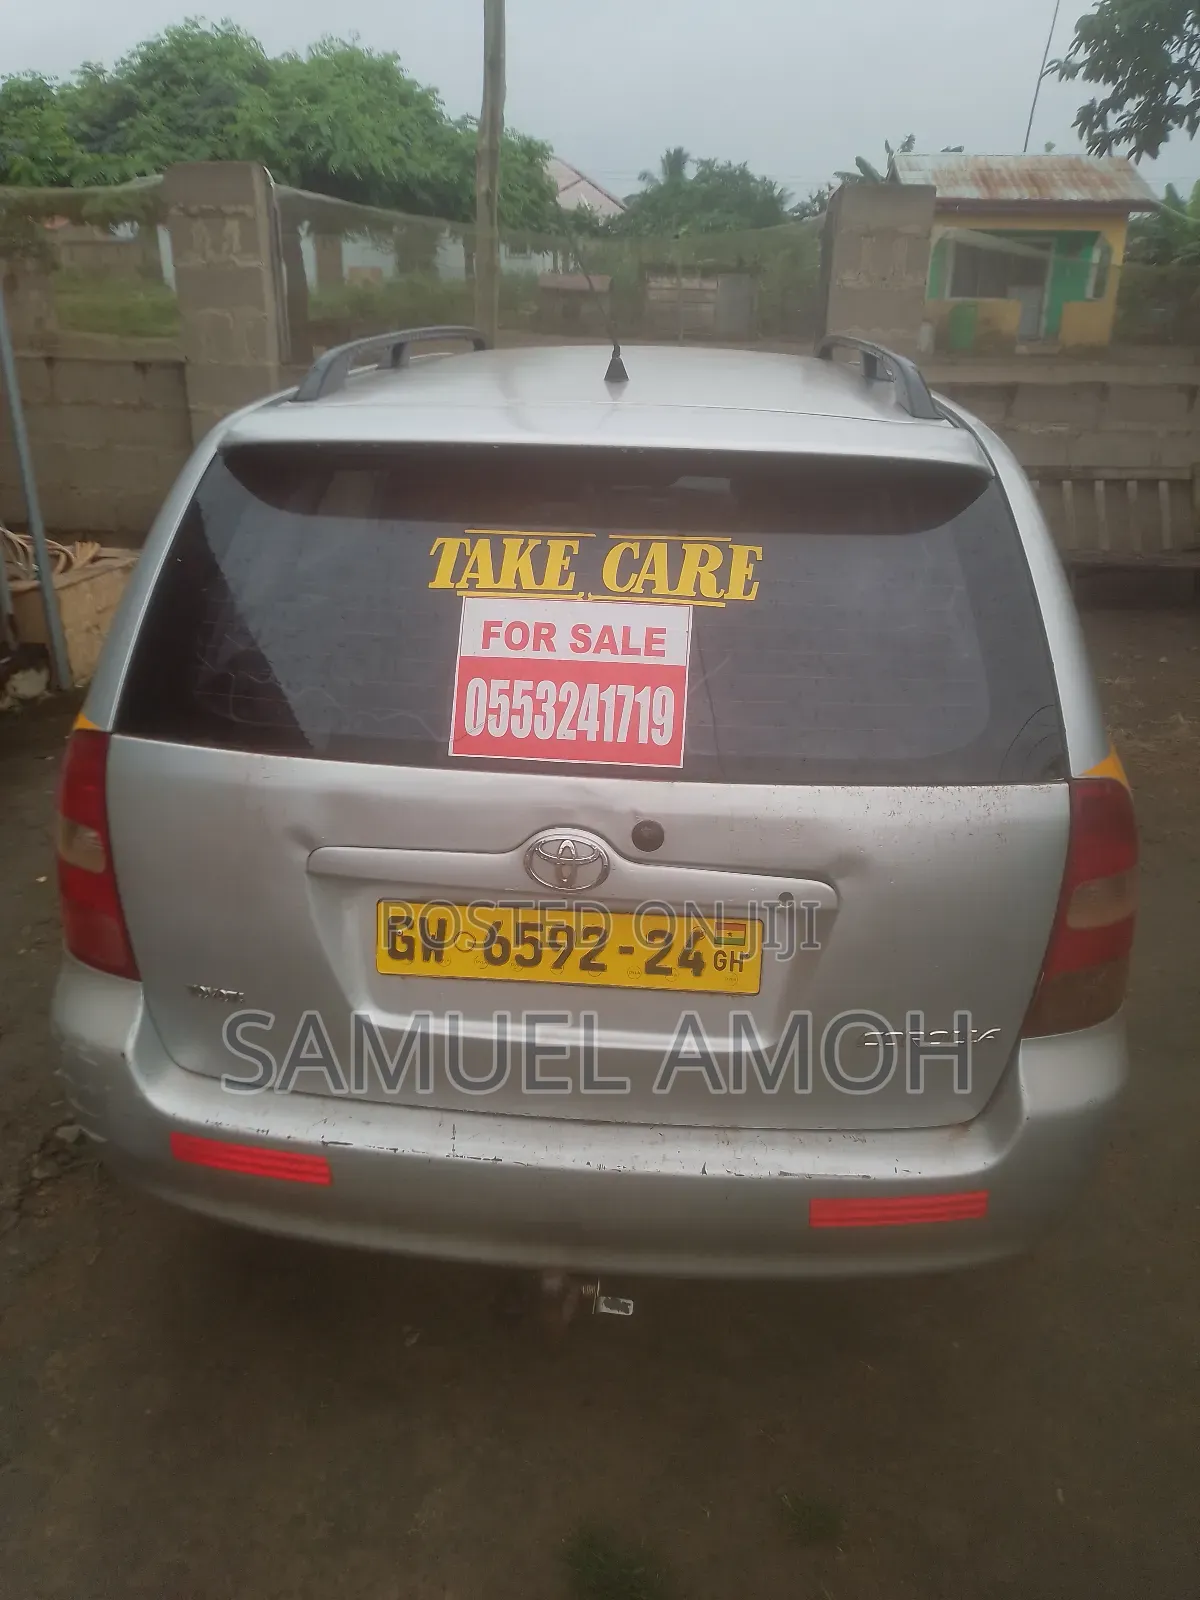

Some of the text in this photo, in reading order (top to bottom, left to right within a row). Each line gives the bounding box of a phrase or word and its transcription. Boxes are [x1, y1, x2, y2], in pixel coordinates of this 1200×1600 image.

[428, 537, 763, 601] TAKE CARE
[481, 620, 667, 657] FOR SALE
[464, 677, 675, 747] 0553241719
[387, 915, 448, 963] GW
[713, 949, 745, 972] GH
